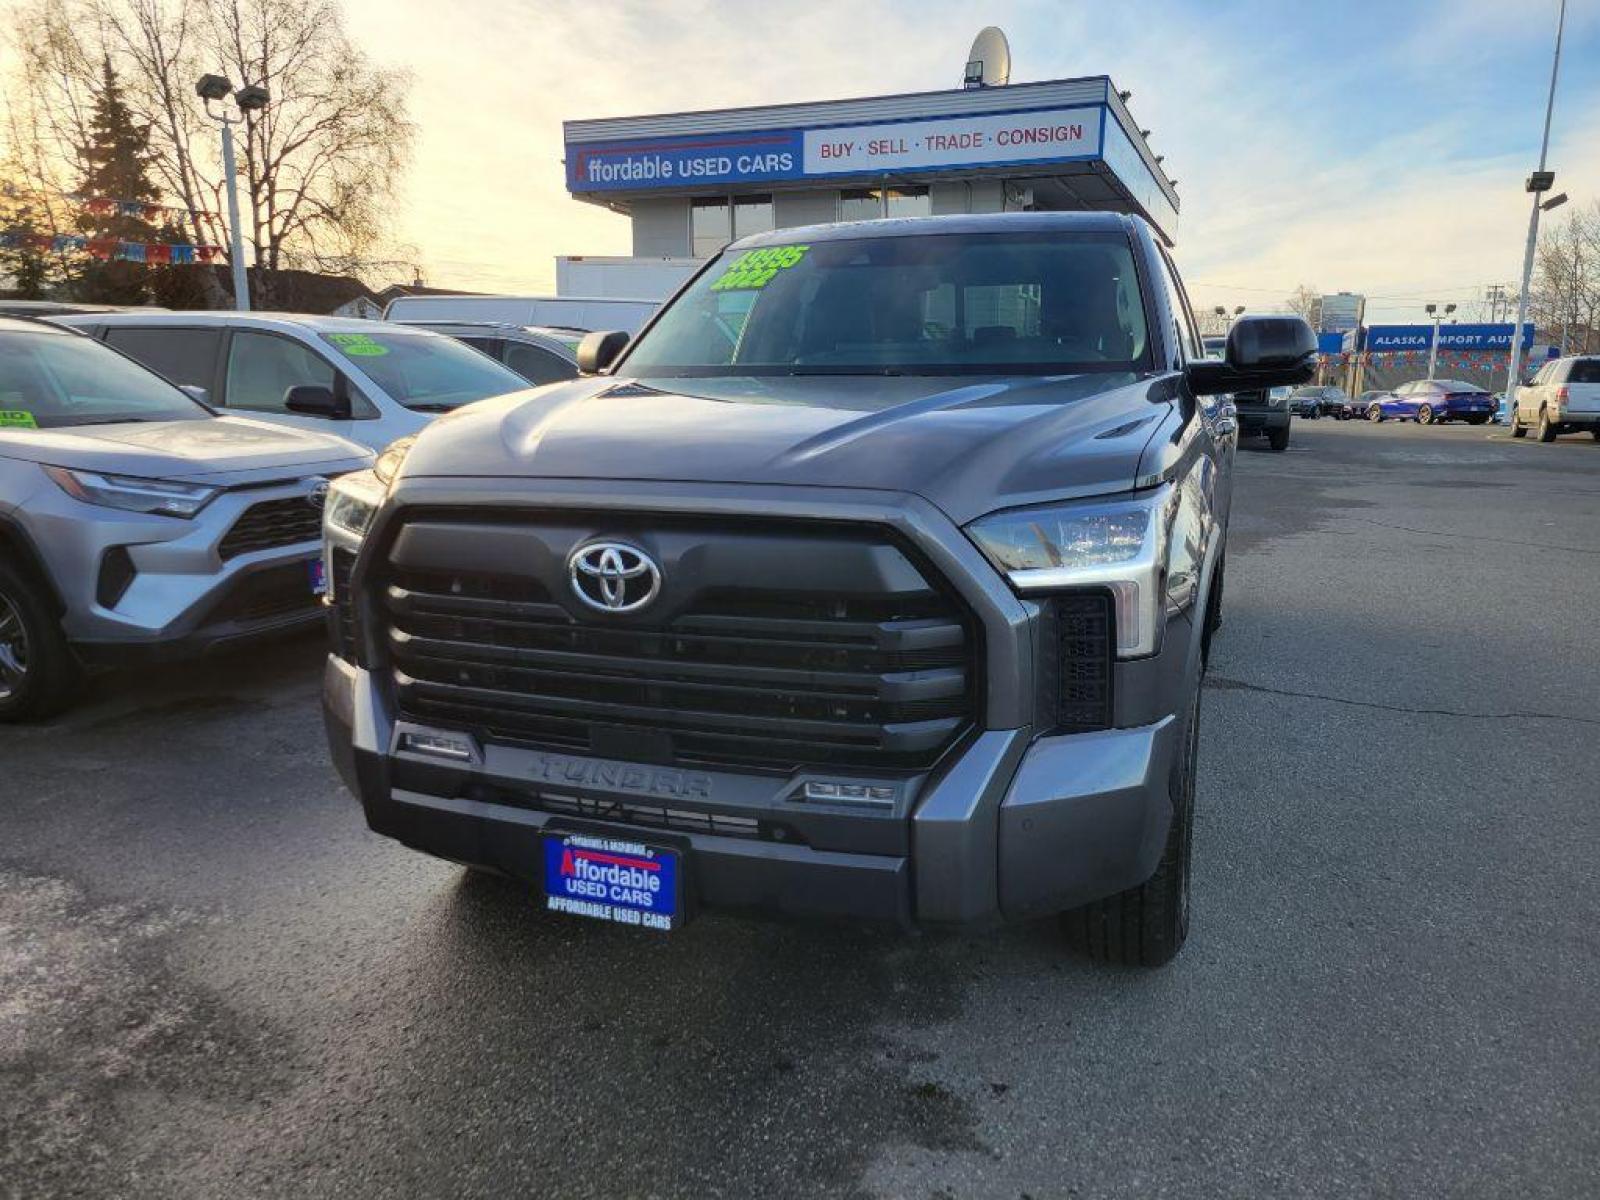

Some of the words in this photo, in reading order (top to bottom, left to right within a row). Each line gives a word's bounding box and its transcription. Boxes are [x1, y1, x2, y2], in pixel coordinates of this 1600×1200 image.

[821, 143, 854, 159] BUY
[868, 139, 909, 156] SELL
[925, 132, 982, 152] TRADE
[997, 124, 1083, 147] CONSIGN
[678, 157, 732, 178] USED
[737, 152, 794, 173] CARS
[1374, 336, 1427, 346] ALASKA
[536, 753, 713, 798] TUNDRA
[561, 849, 661, 893] Affordable
[566, 877, 608, 898] USED
[610, 885, 653, 907] CARS
[547, 896, 612, 920] AFFORDABLE
[613, 906, 641, 925] USED
[642, 912, 672, 930] CARS
